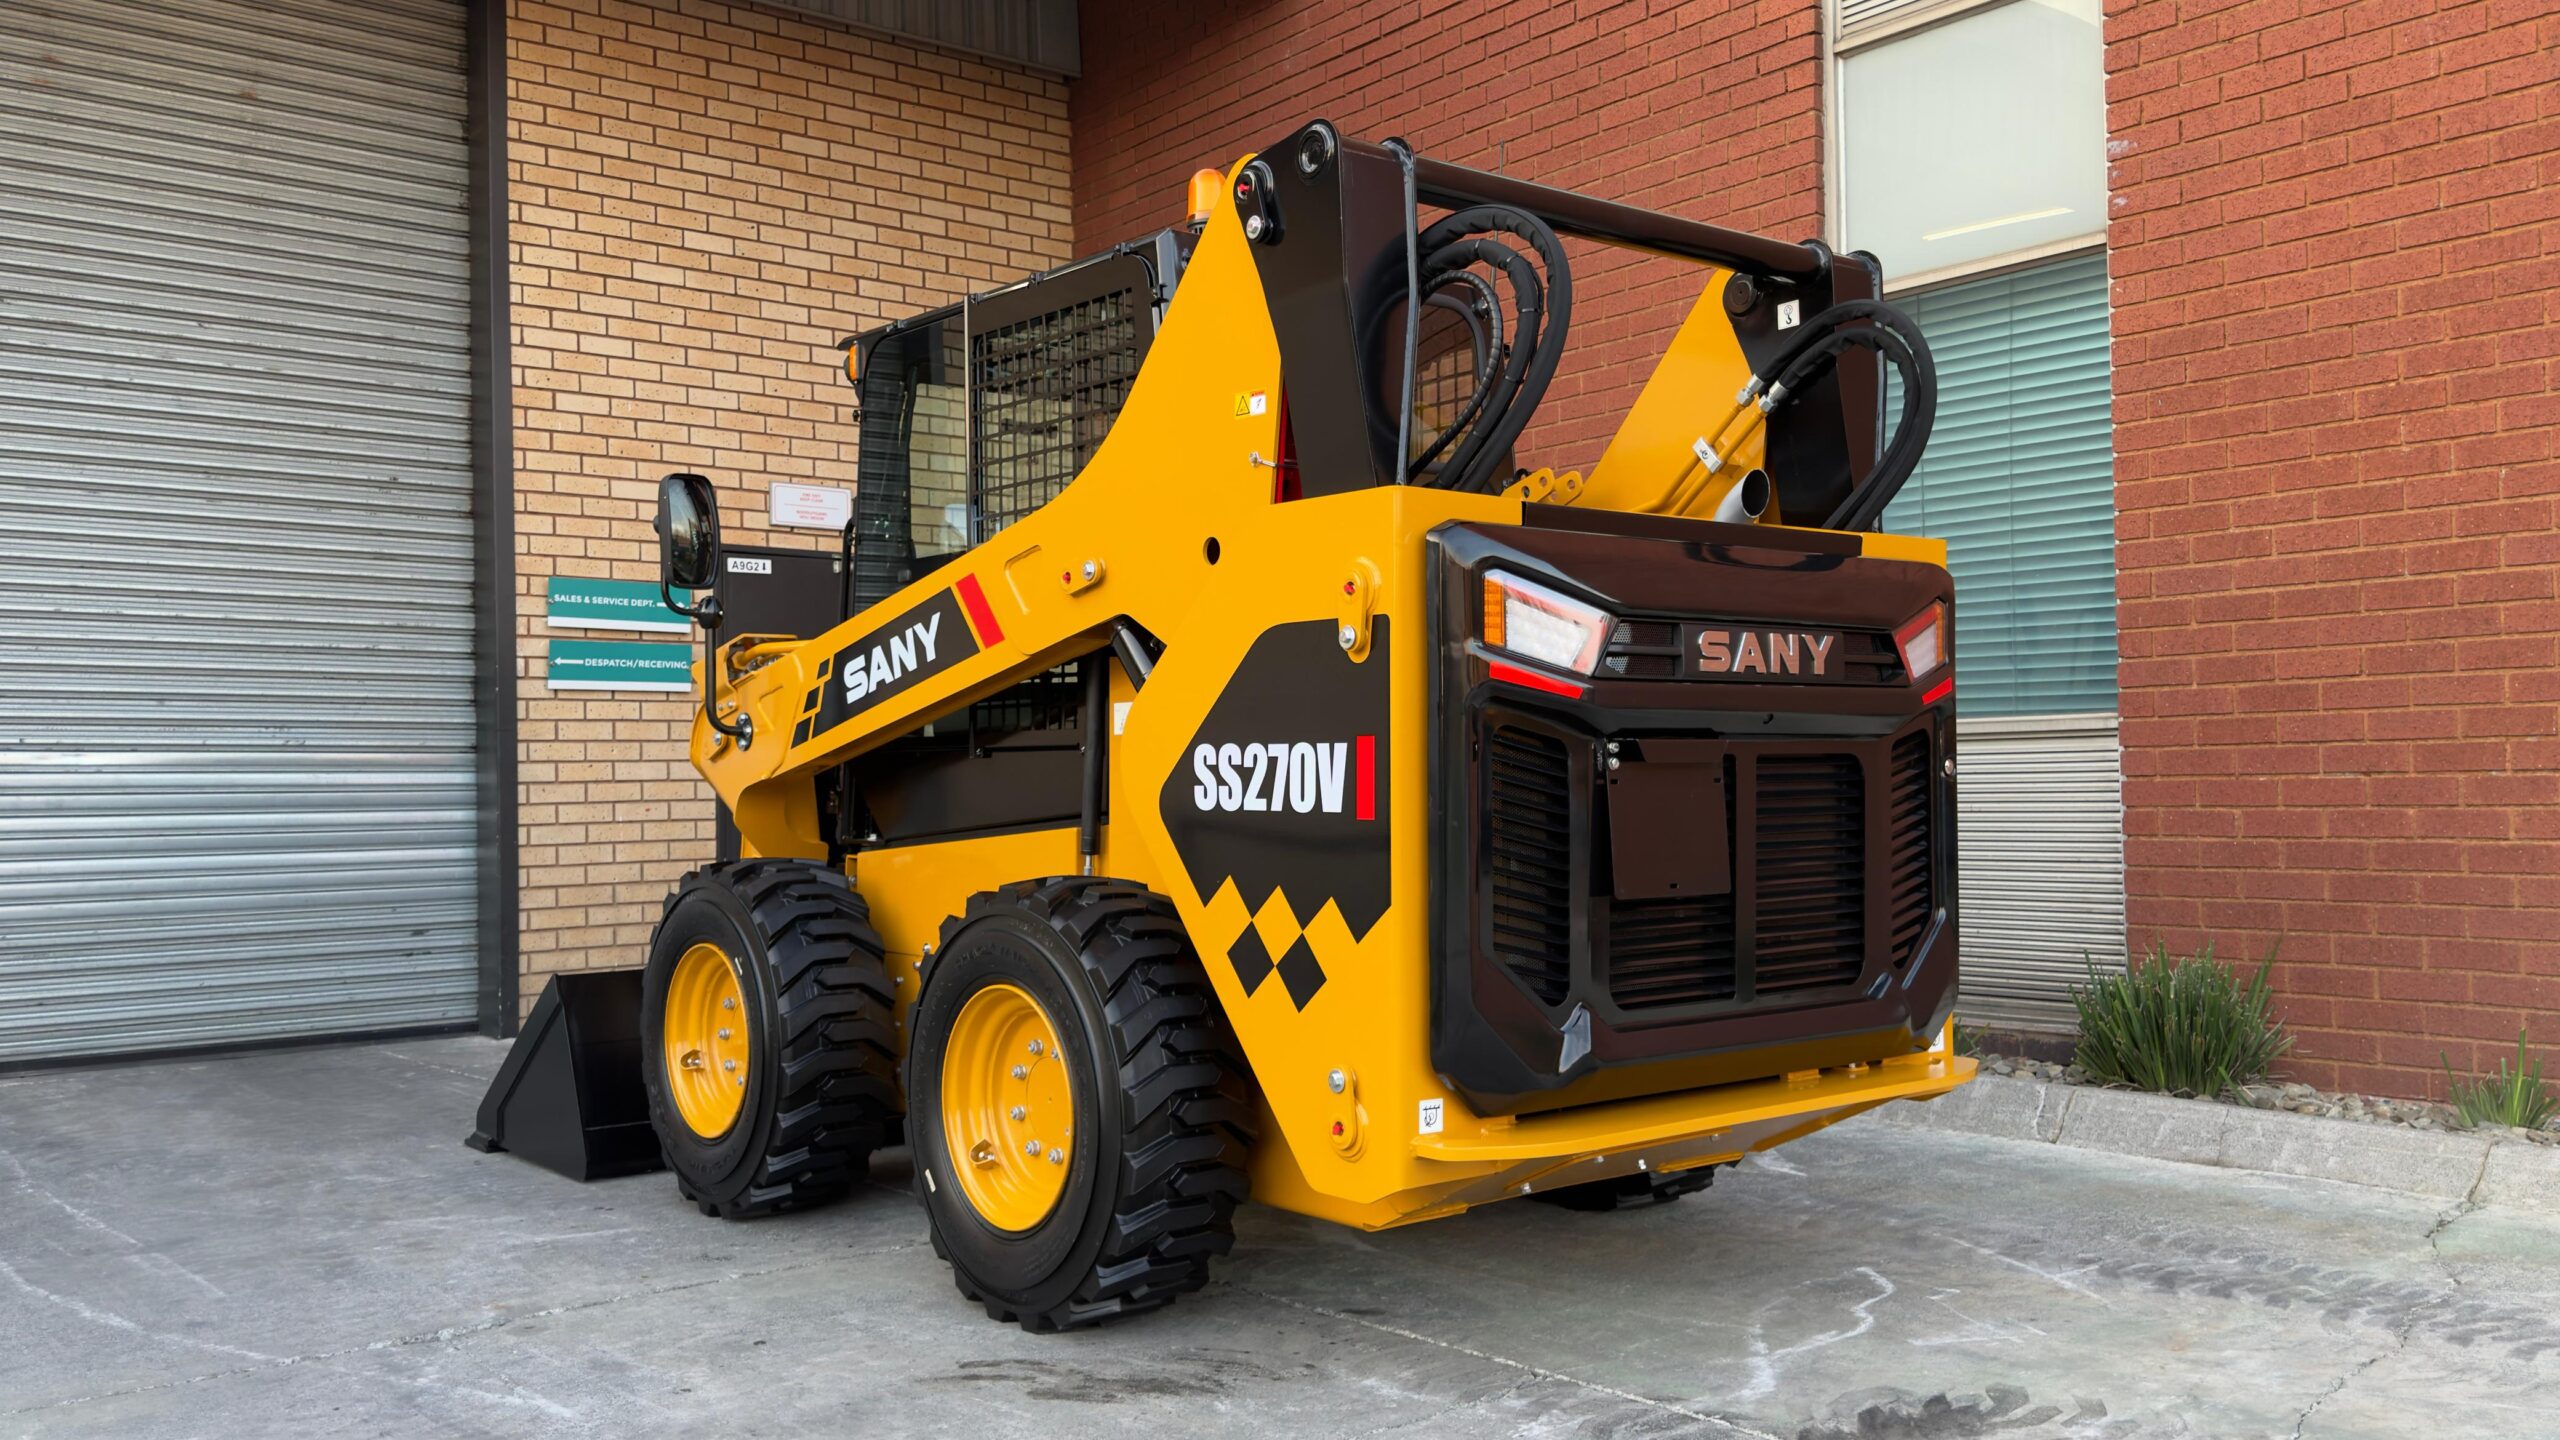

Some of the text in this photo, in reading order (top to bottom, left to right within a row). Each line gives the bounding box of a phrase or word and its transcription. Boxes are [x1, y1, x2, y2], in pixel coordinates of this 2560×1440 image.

[554, 594, 655, 608] SALES & SERVICE DEPT.
[843, 611, 941, 704] SANY
[1698, 630, 1834, 675] SANY
[1194, 742, 1348, 813] SS270V
